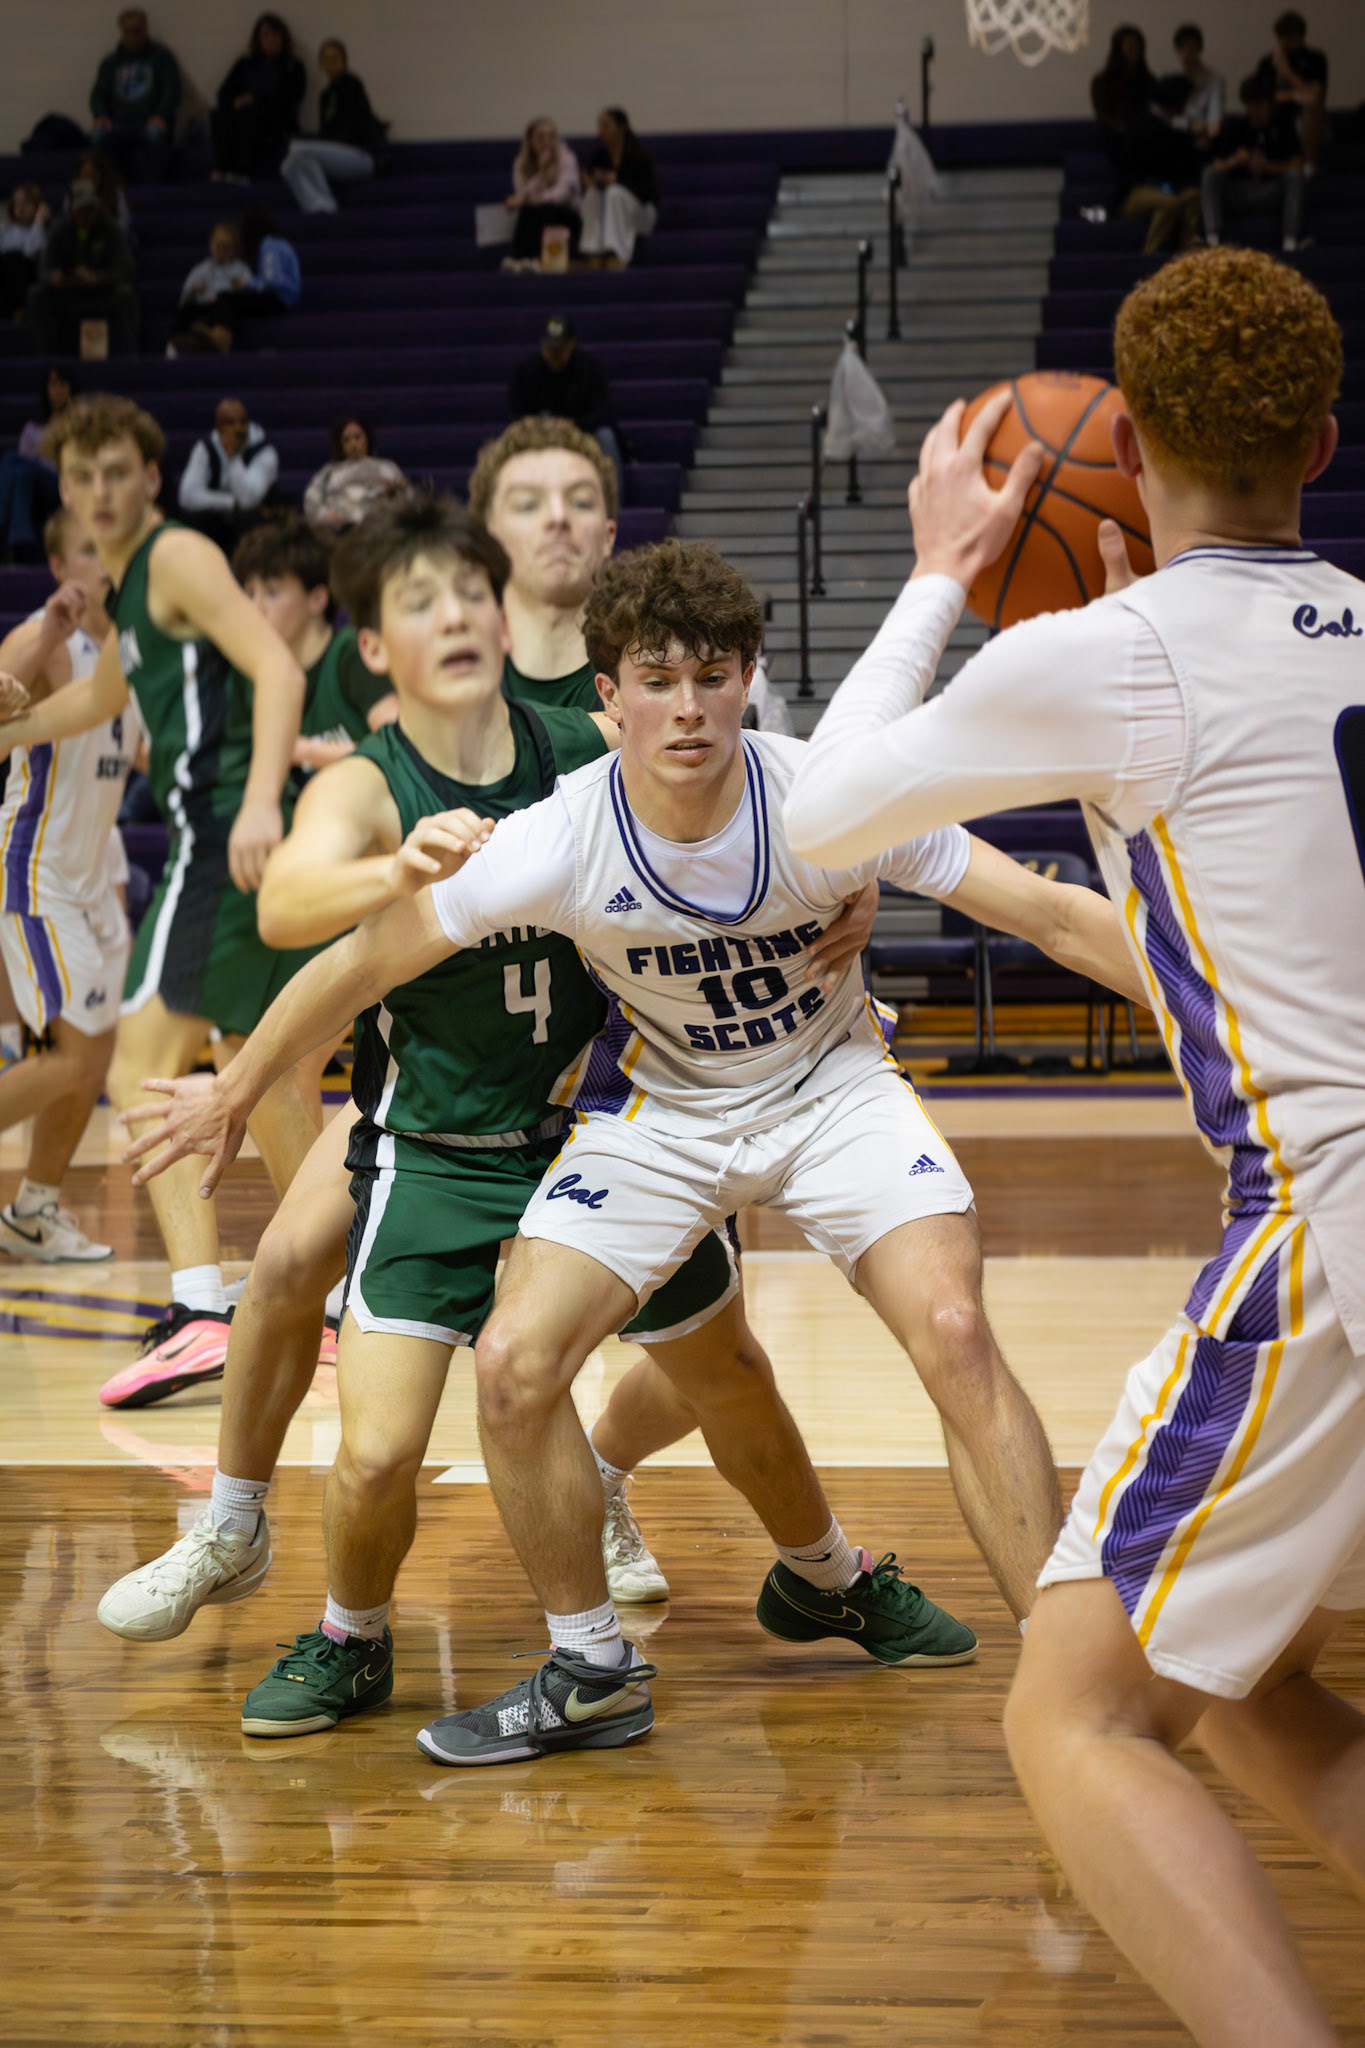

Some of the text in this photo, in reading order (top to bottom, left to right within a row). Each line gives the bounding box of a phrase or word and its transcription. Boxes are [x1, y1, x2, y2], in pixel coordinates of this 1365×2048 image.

[1293, 603, 1363, 638] Cal
[604, 902, 643, 913] adidas
[626, 920, 825, 977] FIGHTING
[503, 957, 552, 1045] 4
[697, 966, 790, 1020] 10
[683, 986, 826, 1051] SCOTS
[546, 1173, 609, 1210] Cal
[908, 1166, 945, 1176] adidas
